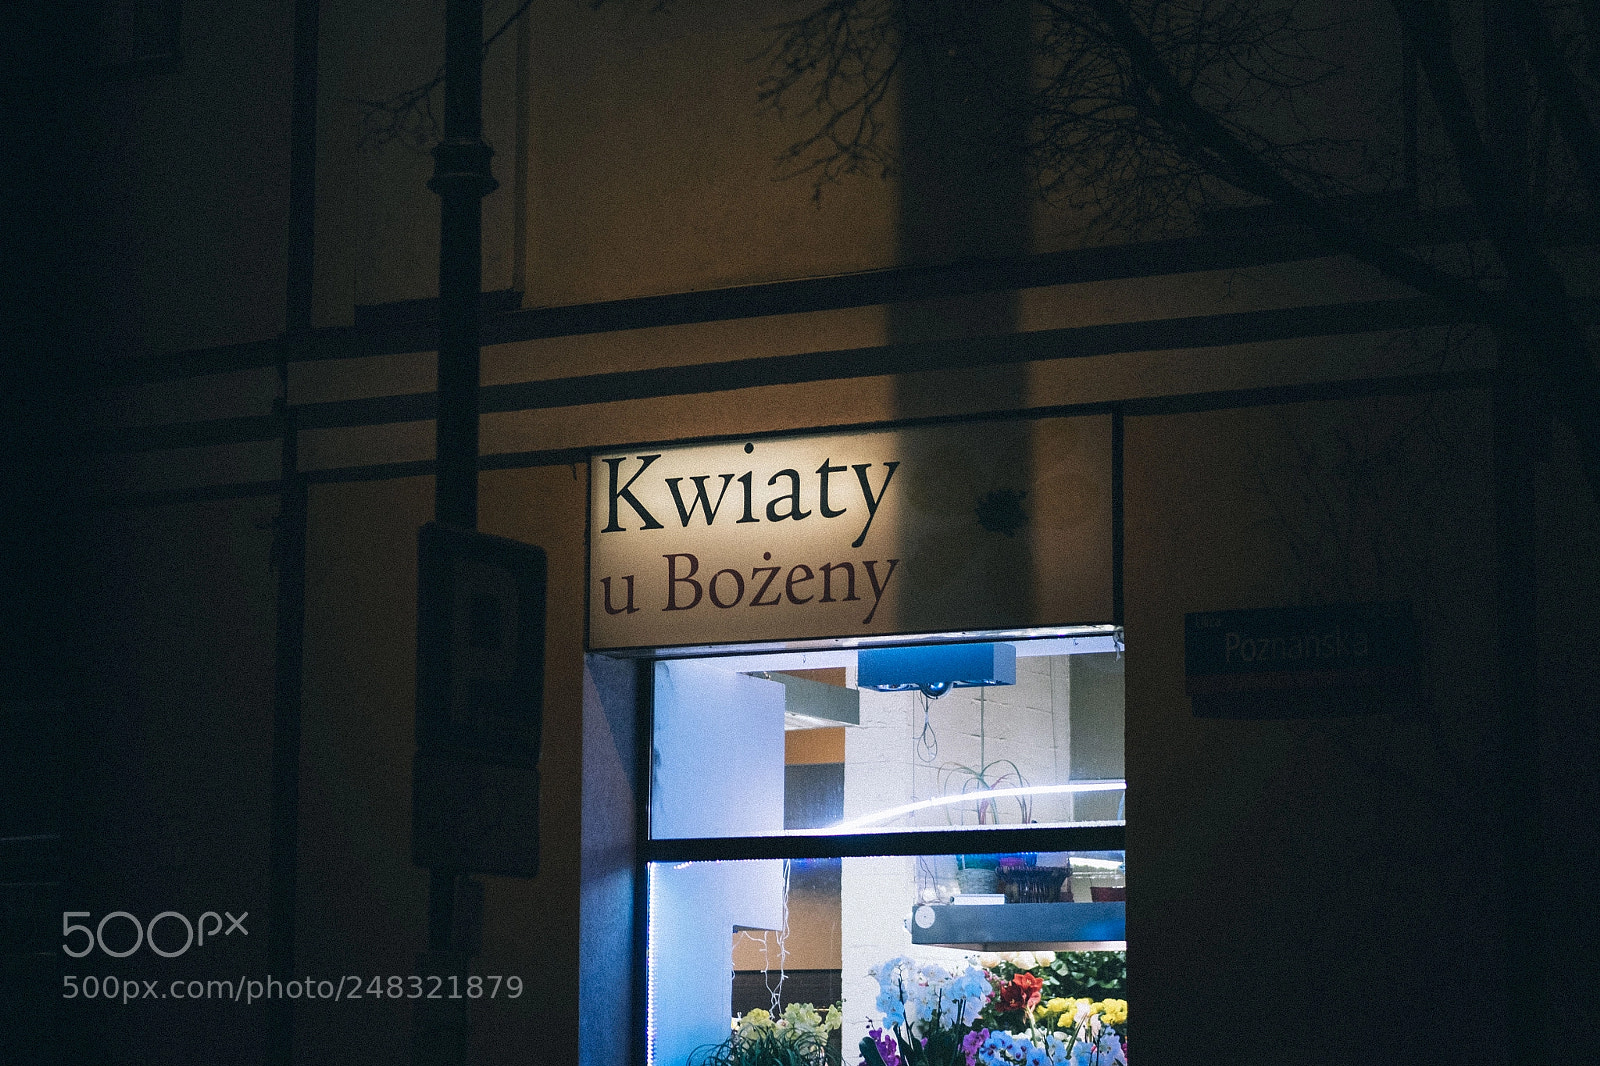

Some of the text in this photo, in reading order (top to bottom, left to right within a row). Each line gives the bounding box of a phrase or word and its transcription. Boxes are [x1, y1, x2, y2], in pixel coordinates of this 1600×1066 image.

[600, 442, 900, 548] Kwiaty
[600, 552, 899, 624] u Bożeny
